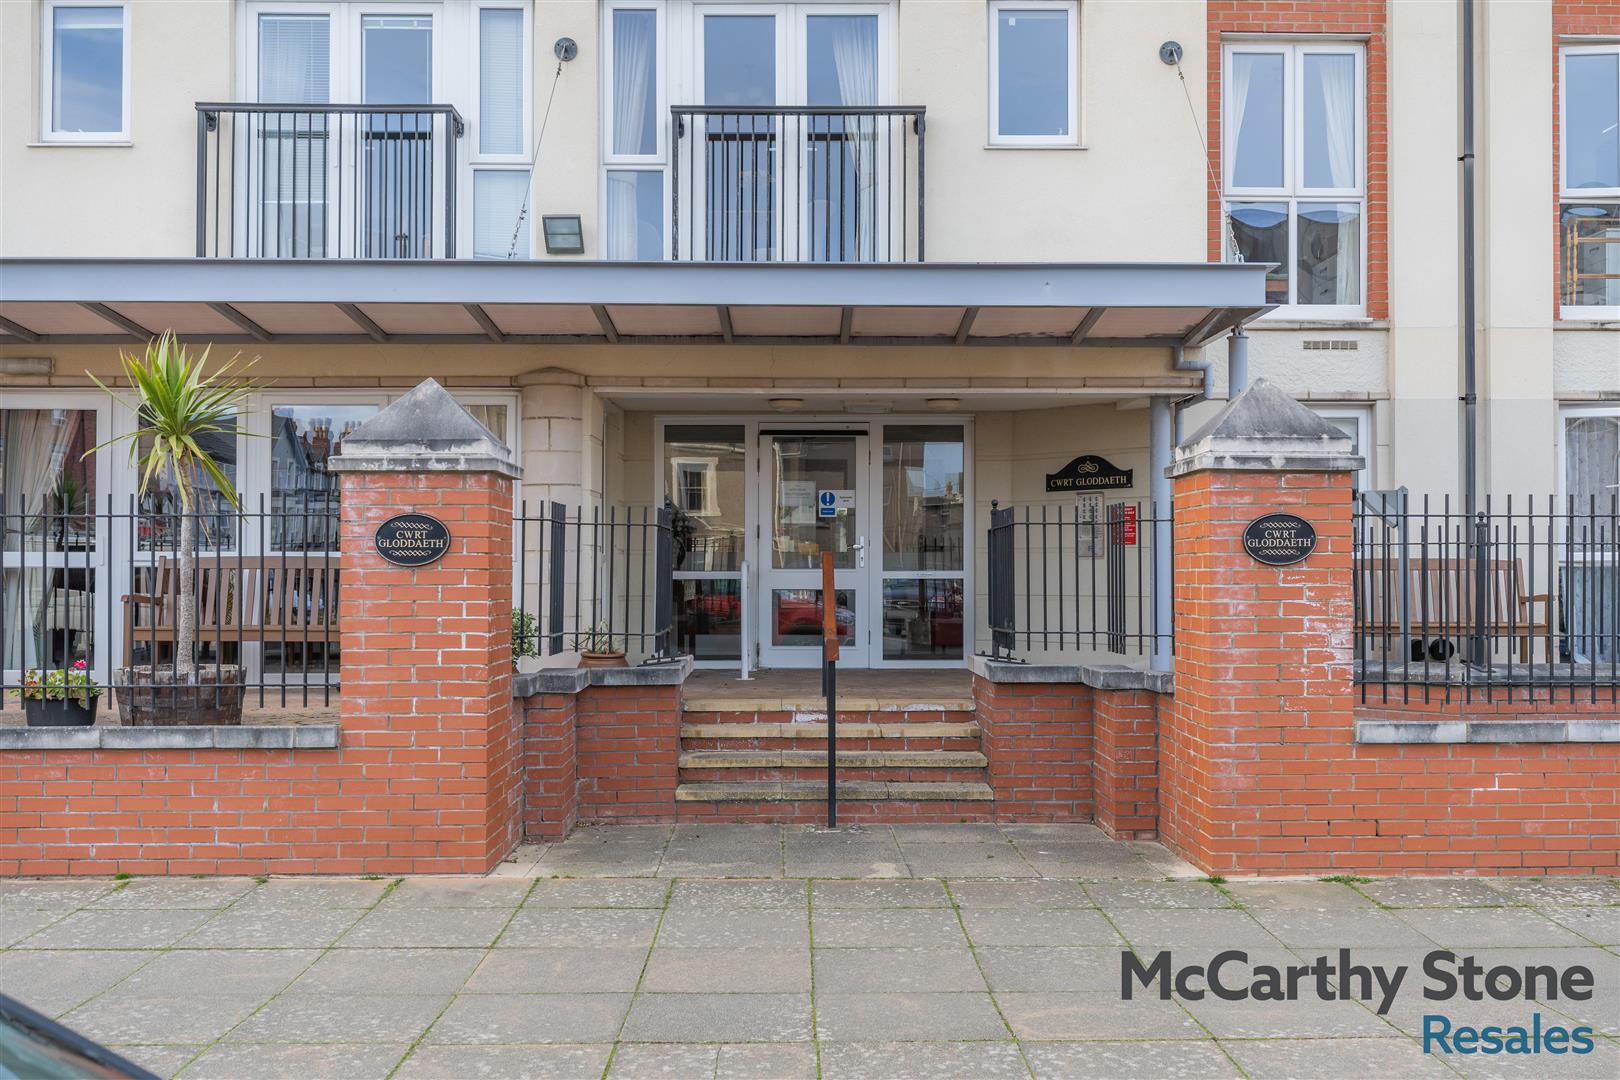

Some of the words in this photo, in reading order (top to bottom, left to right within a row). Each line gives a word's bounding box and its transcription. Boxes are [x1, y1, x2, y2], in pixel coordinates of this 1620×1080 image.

[1050, 478, 1073, 487] CWRT
[1076, 475, 1127, 486] GLODDAETH
[396, 530, 428, 539] CWRT
[1265, 530, 1297, 539] CWRT
[378, 539, 443, 548] GLODDAETH
[1247, 538, 1311, 547] GLODDAETH
